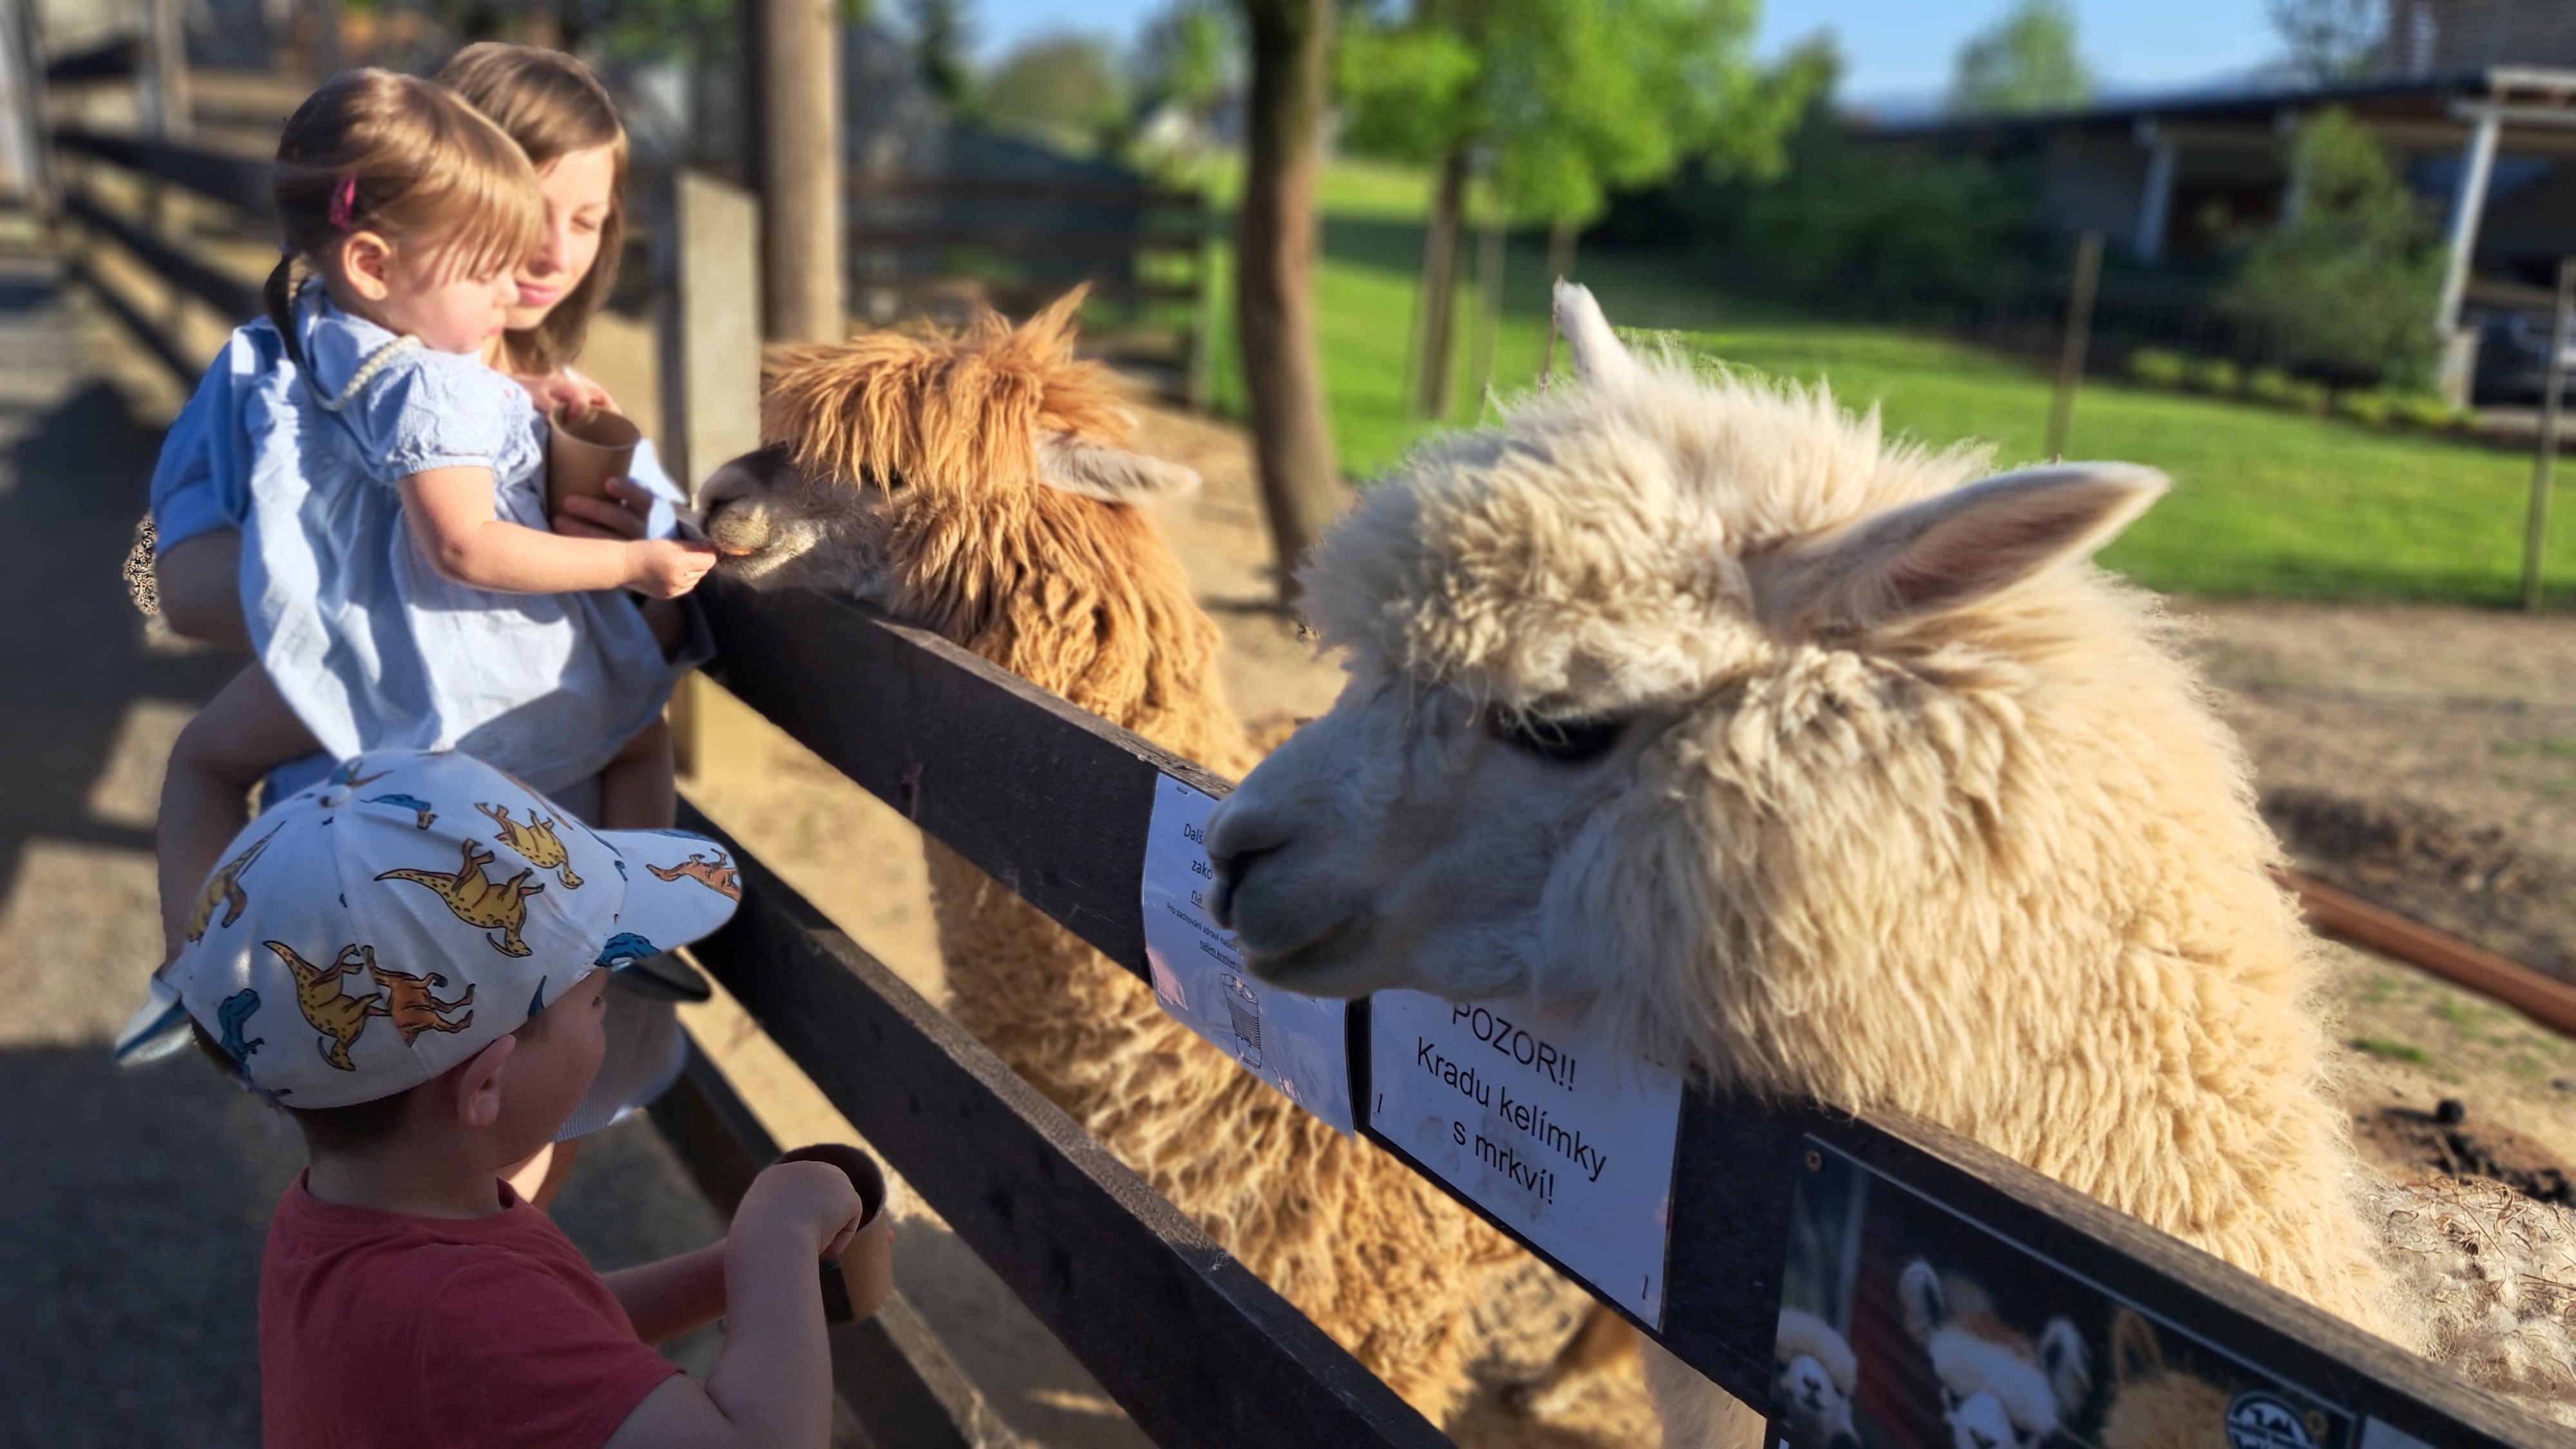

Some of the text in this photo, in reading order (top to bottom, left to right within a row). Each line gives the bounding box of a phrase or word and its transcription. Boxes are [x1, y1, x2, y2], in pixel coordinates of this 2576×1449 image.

[1452, 1003, 1576, 1092] POZOR!!
[1417, 1036, 1607, 1182] Kradu kelímky
[1453, 1121, 1555, 1204] s mrkví!
